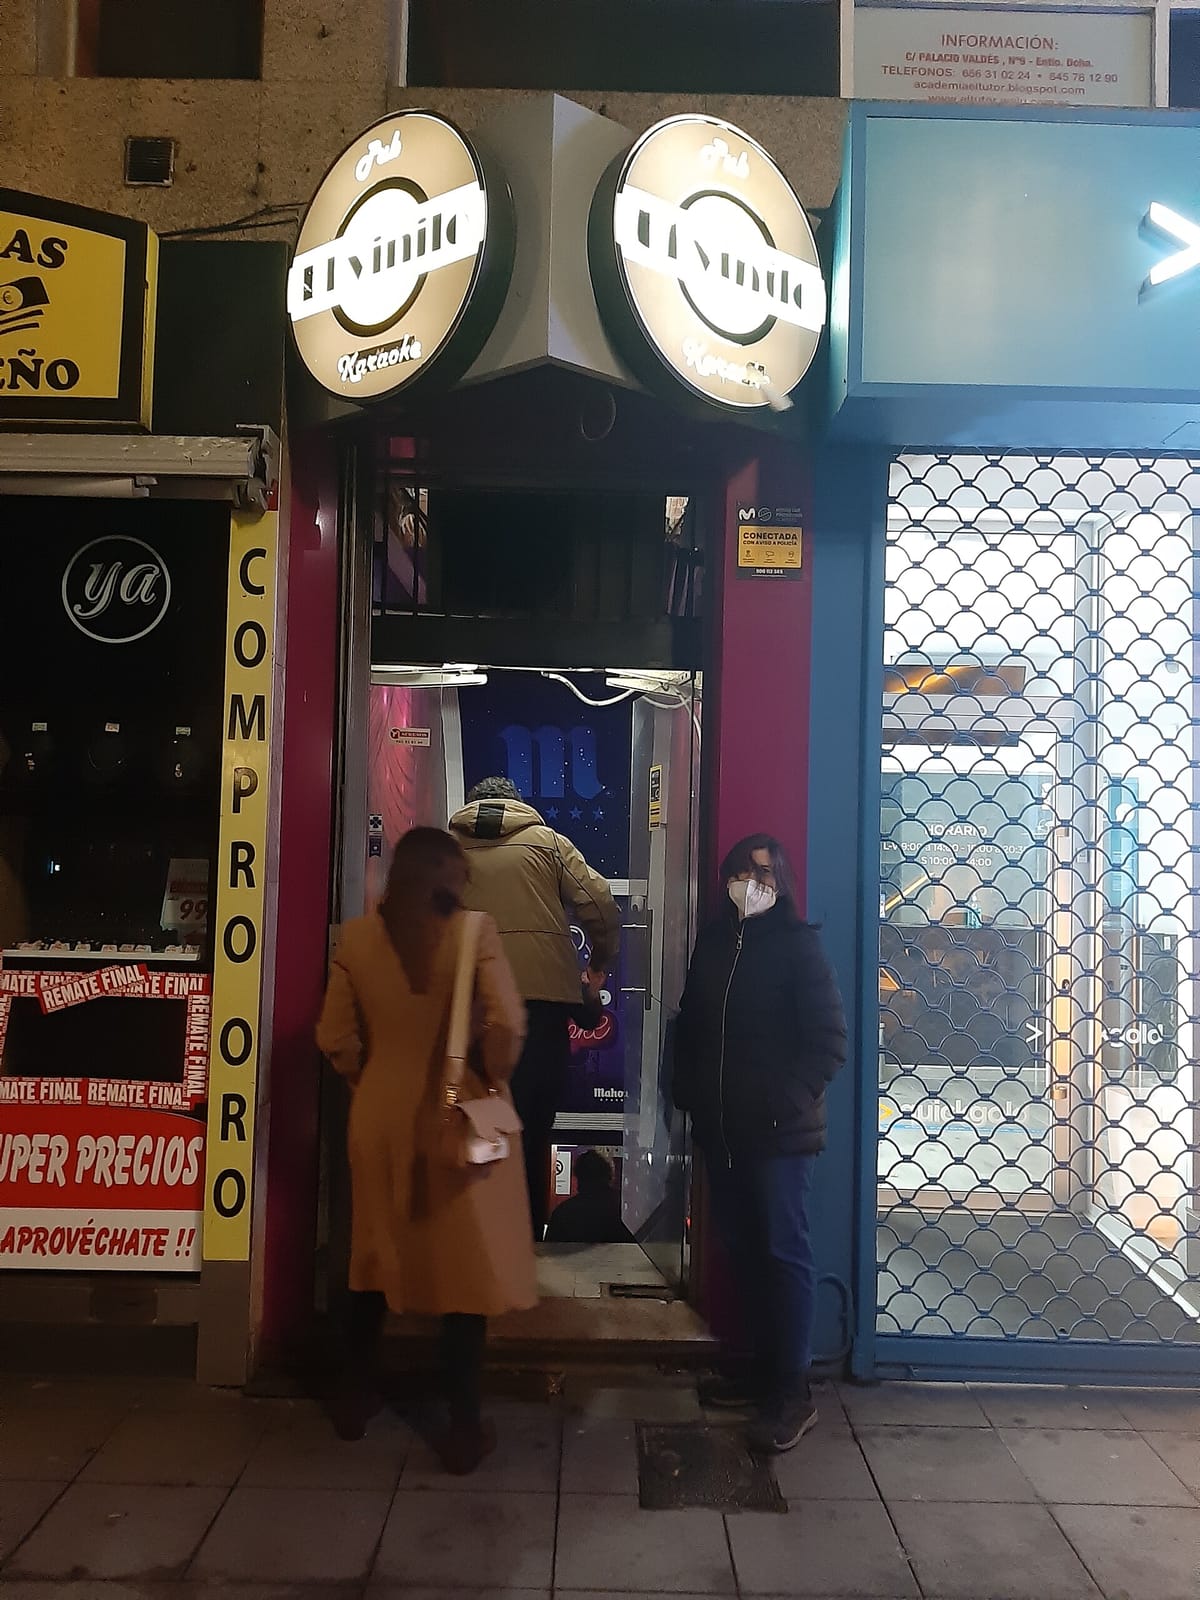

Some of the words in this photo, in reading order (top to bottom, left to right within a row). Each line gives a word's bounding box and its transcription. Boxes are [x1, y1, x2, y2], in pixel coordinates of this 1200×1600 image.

[905, 52, 916, 61] C/
[919, 53, 960, 63] PALACIO
[941, 34, 1059, 50] INFORMACIÓN:
[985, 70, 997, 79] 31
[1017, 71, 1031, 80] 24
[1089, 73, 1102, 83] 12
[1104, 74, 1118, 83] 90
[0, 348, 81, 392] ÑO
[742, 532, 798, 540] CONECTADA
[73, 560, 161, 620] ya
[222, 546, 268, 964] COMPRO
[42, 976, 100, 1009] REMATE
[101, 965, 145, 991] FINAL
[189, 995, 210, 1051] REMATE
[40, 1082, 82, 1101] FINAL
[88, 1082, 145, 1104] REMATE
[187, 1055, 207, 1098] FINAL
[212, 1016, 253, 1219] ORO
[75, 1134, 204, 1188] PRECIOS
[0, 1218, 170, 1257] APROVÉCHATE
